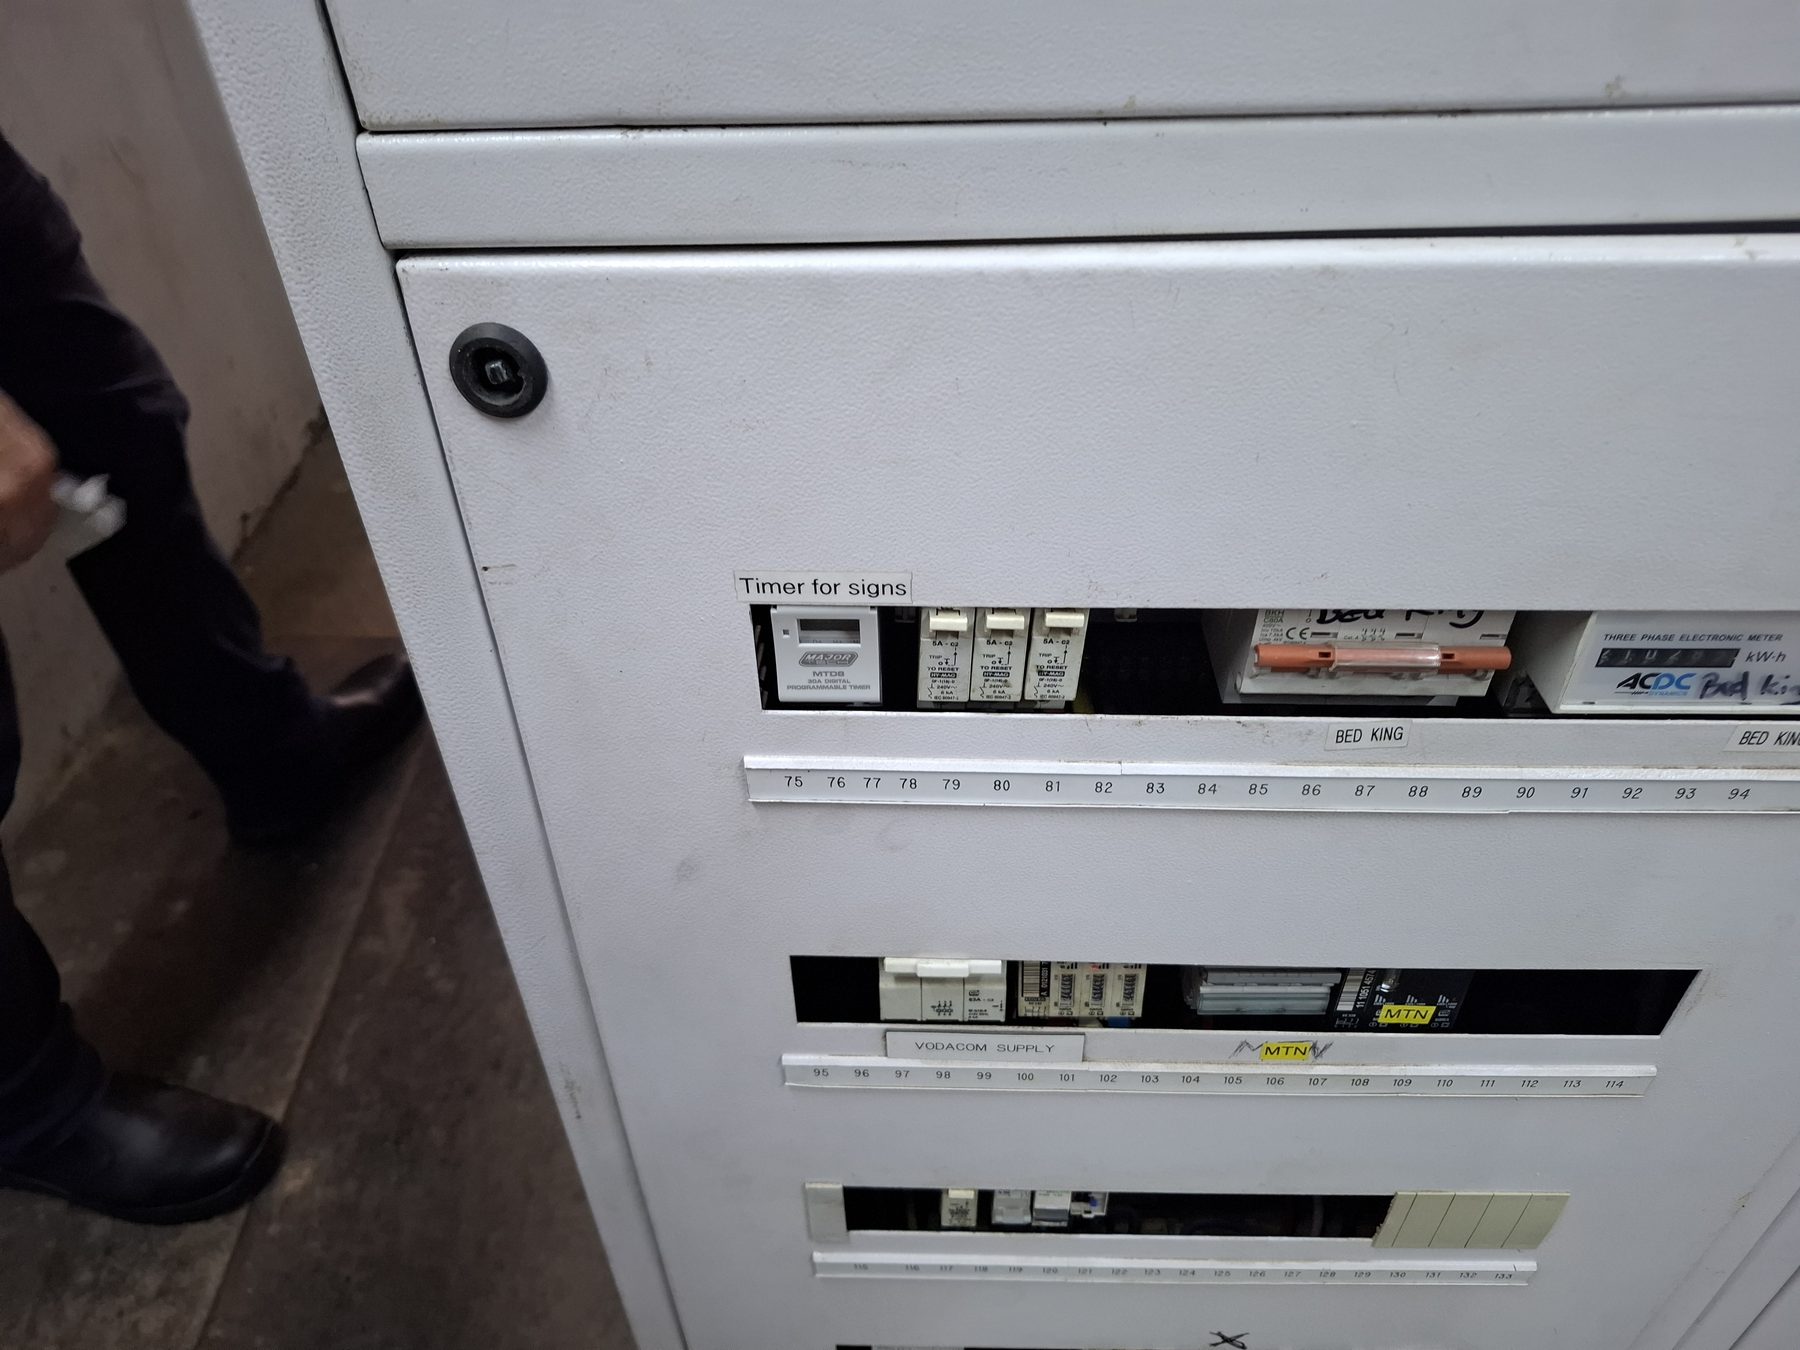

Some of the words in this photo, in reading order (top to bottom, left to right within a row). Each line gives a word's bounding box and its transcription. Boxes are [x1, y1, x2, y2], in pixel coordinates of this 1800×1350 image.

[739, 577, 805, 595] Timer
[811, 578, 841, 596] for
[848, 579, 907, 599] signs
[1603, 633, 1637, 642] THREE
[1640, 633, 1675, 642] PHASE
[1678, 633, 1743, 642] ELECTRONIC
[1747, 633, 1784, 642] METER
[1616, 672, 1697, 690] ACDC
[1335, 728, 1363, 744] BED
[1370, 725, 1404, 743] KING
[1738, 730, 1770, 746] BED
[784, 776, 804, 788] 75
[827, 777, 846, 789] 76
[863, 777, 882, 789] 77
[900, 778, 918, 790] 78
[943, 779, 961, 791] 79
[993, 779, 1011, 792] 80
[1045, 781, 1061, 792] 81
[1095, 781, 1113, 793] 82
[1146, 782, 1165, 794] 83
[1197, 783, 1217, 795] 84
[1248, 783, 1269, 795] 85
[1302, 784, 1322, 796] 86
[1355, 785, 1376, 797] 87
[1408, 785, 1429, 798] 88
[1462, 786, 1483, 798] 89
[1516, 787, 1536, 799] 90
[1570, 787, 1589, 799] 91
[1621, 787, 1644, 800] 92
[1674, 787, 1697, 800] 93
[1727, 788, 1751, 800] 94
[1358, 985, 1371, 1000] 1051
[1355, 1001, 1366, 1009] 11
[1384, 1008, 1429, 1019] MTN
[915, 1041, 987, 1052] VODACOM
[996, 1043, 1055, 1053] SUPPLY
[1264, 1046, 1308, 1056] MTN
[813, 1068, 829, 1077] 95
[854, 1068, 870, 1077] 96
[895, 1069, 910, 1078] 97
[936, 1070, 951, 1079] 98
[976, 1071, 992, 1080] 99
[1017, 1072, 1034, 1081] 100
[1059, 1073, 1075, 1082] 101
[1100, 1074, 1118, 1083] 102
[1141, 1074, 1159, 1083] 103
[1182, 1075, 1200, 1083] 104
[1224, 1076, 1243, 1084] 105
[1266, 1077, 1285, 1086] 106
[1308, 1077, 1327, 1086] 107
[1350, 1077, 1370, 1087] 108
[1393, 1078, 1412, 1087] 109
[1436, 1079, 1454, 1088] 110
[1480, 1079, 1496, 1088] 111
[1521, 1079, 1539, 1088] 112
[1563, 1080, 1581, 1088] 113
[1605, 1080, 1624, 1089] 114
